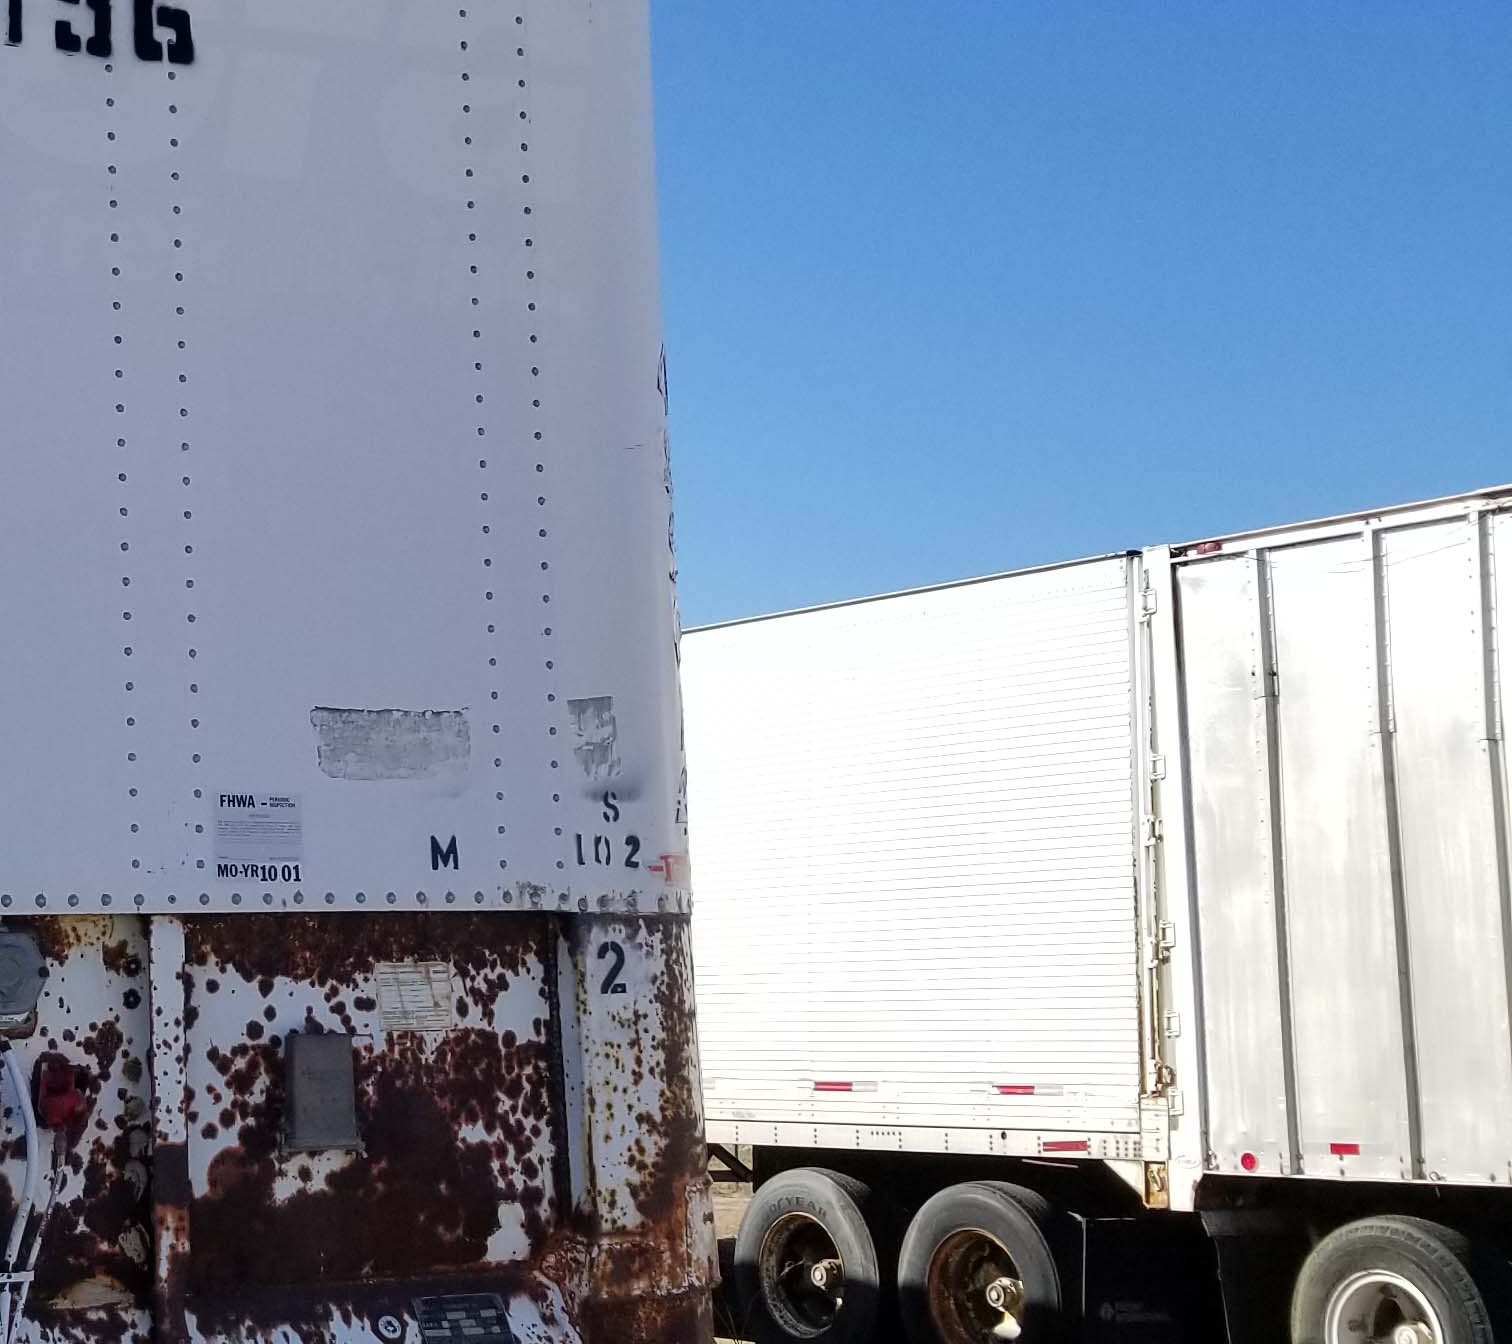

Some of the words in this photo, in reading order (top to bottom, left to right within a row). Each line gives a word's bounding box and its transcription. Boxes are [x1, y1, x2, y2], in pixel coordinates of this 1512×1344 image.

[219, 794, 256, 808] FHWA
[602, 791, 620, 823] S
[430, 835, 460, 870] M
[217, 864, 259, 878] MO-YR
[260, 865, 278, 882] 10
[281, 864, 302, 882] 01
[596, 940, 628, 995] 2
